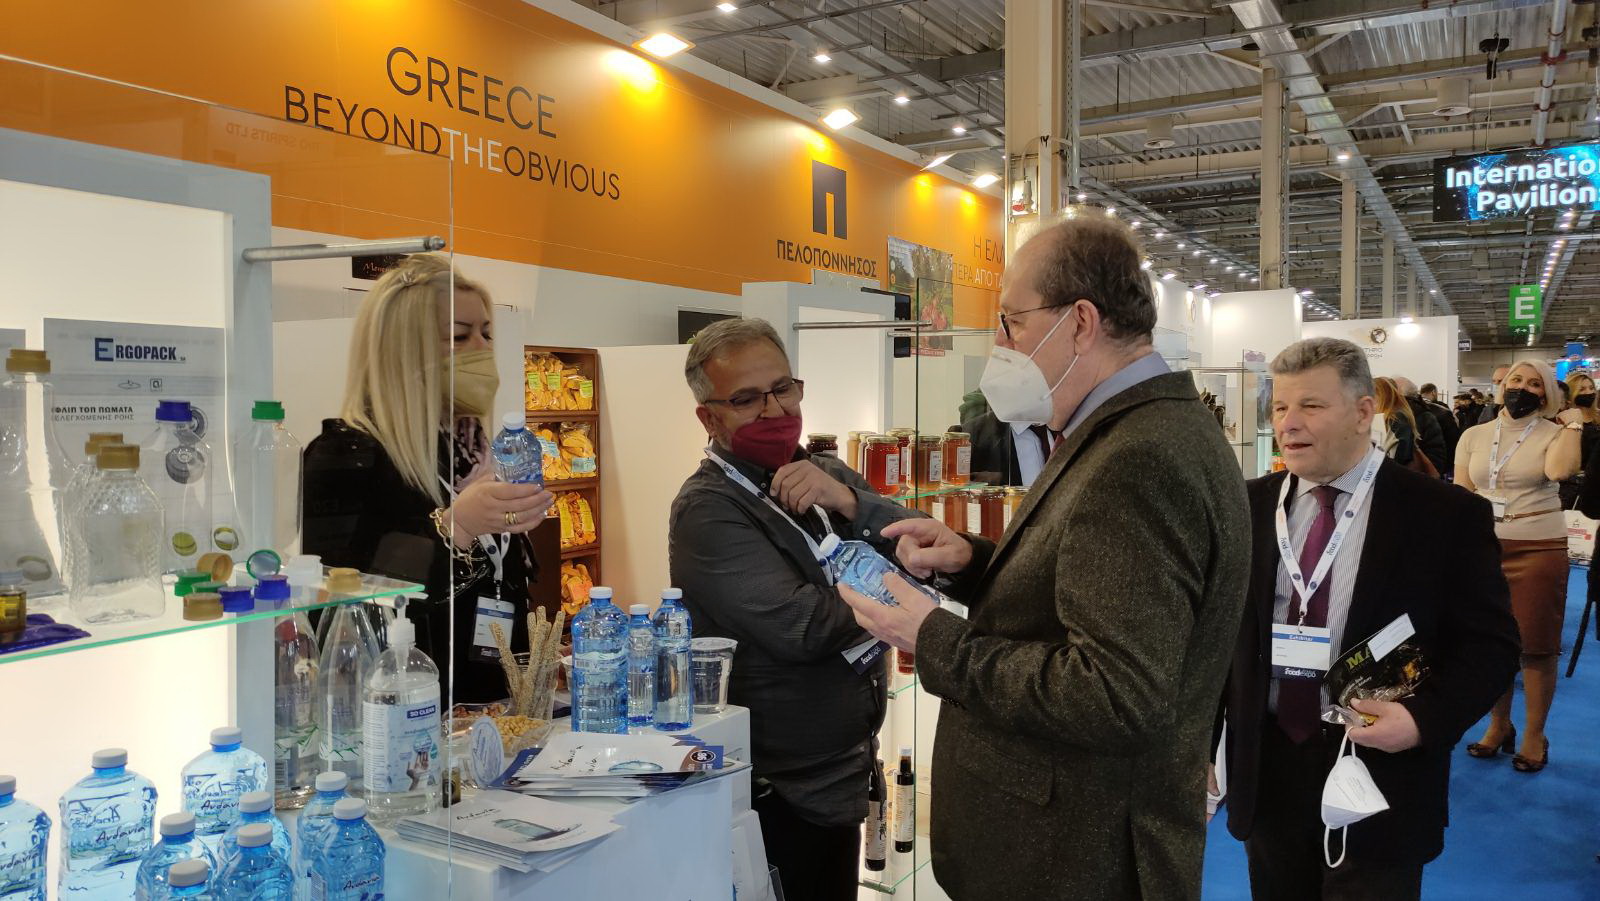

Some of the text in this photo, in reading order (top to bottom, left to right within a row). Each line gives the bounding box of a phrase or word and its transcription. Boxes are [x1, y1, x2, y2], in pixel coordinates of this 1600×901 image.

[386, 46, 557, 139] GREECE
[1446, 153, 1600, 188] Internatio
[1477, 183, 1600, 212] Pavilion
[776, 239, 877, 278] ΠΕΛΟΠΟΝΝΗΣΟΣ
[1514, 296, 1536, 320] E
[94, 337, 177, 362] ERGOPACK
[79, 406, 96, 414] ΤΟΠ
[98, 406, 133, 414] ΠΩΜΑΤΑ
